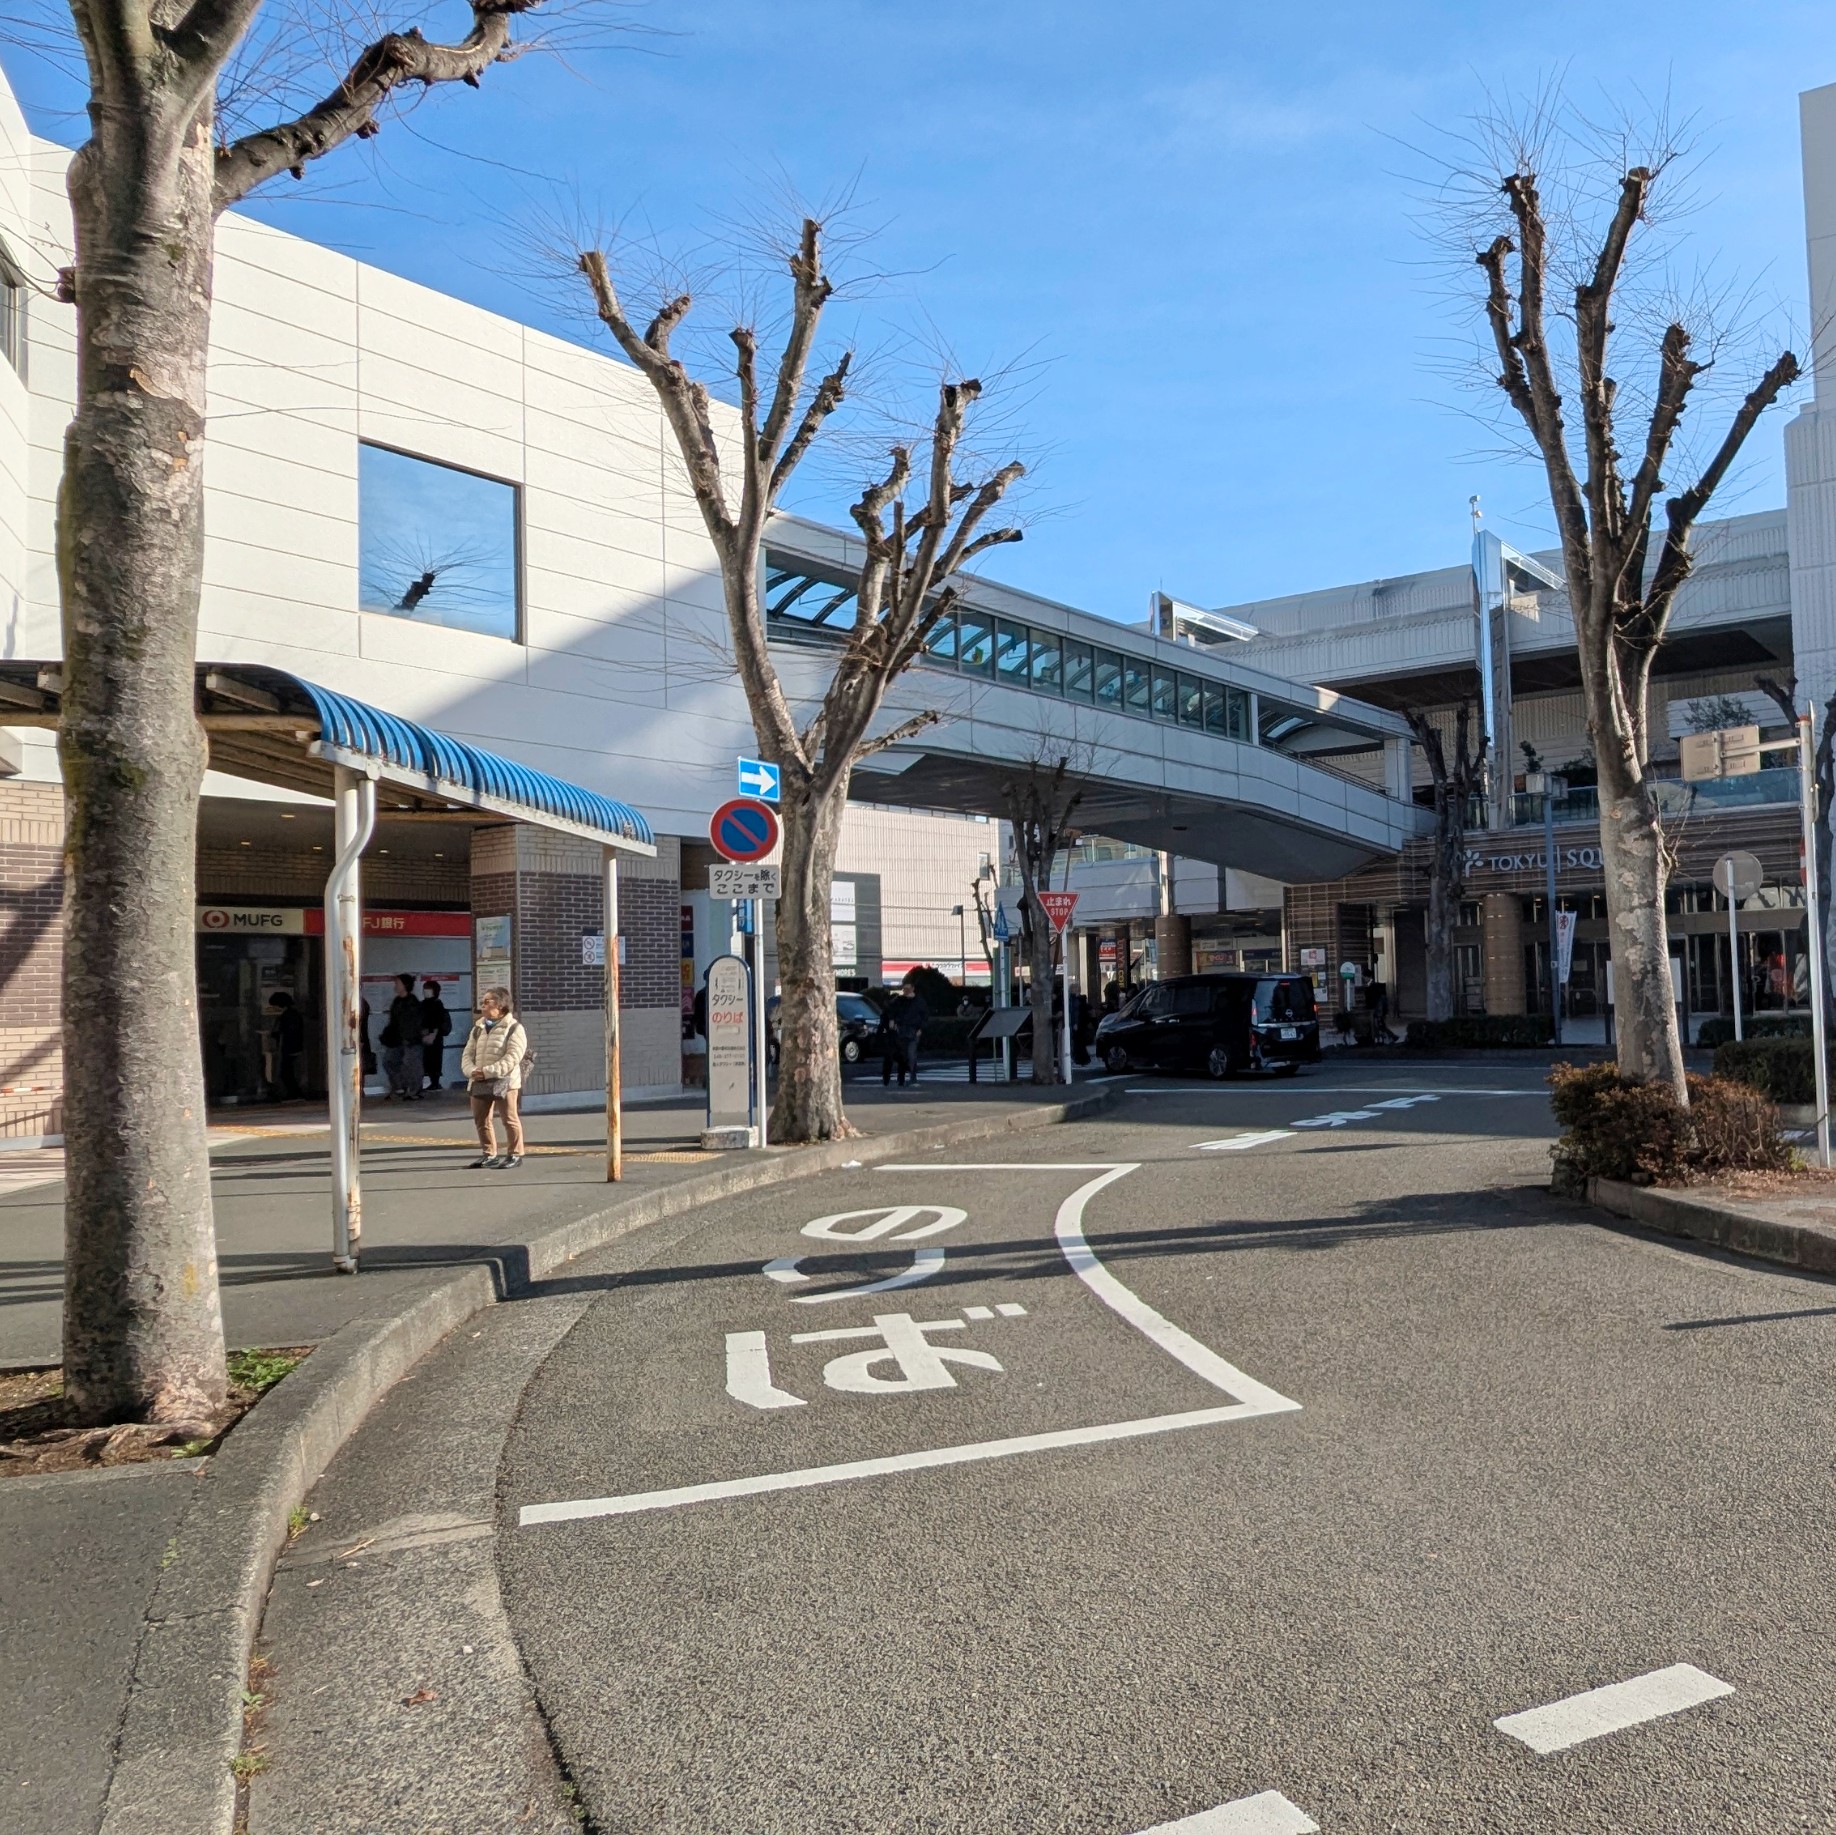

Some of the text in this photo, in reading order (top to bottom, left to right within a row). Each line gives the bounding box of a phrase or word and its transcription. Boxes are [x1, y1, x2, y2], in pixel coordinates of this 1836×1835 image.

[1487, 852, 1548, 872] TOKYU
[714, 869, 777, 881] タクシーを除く
[716, 883, 775, 895] ここまで
[1046, 896, 1072, 907] 止まれ
[1050, 907, 1069, 916] STOP
[233, 913, 283, 927] MUFG
[362, 916, 405, 930] FJ銀行
[712, 993, 744, 1006] タクシー
[712, 1011, 744, 1024] のりば
